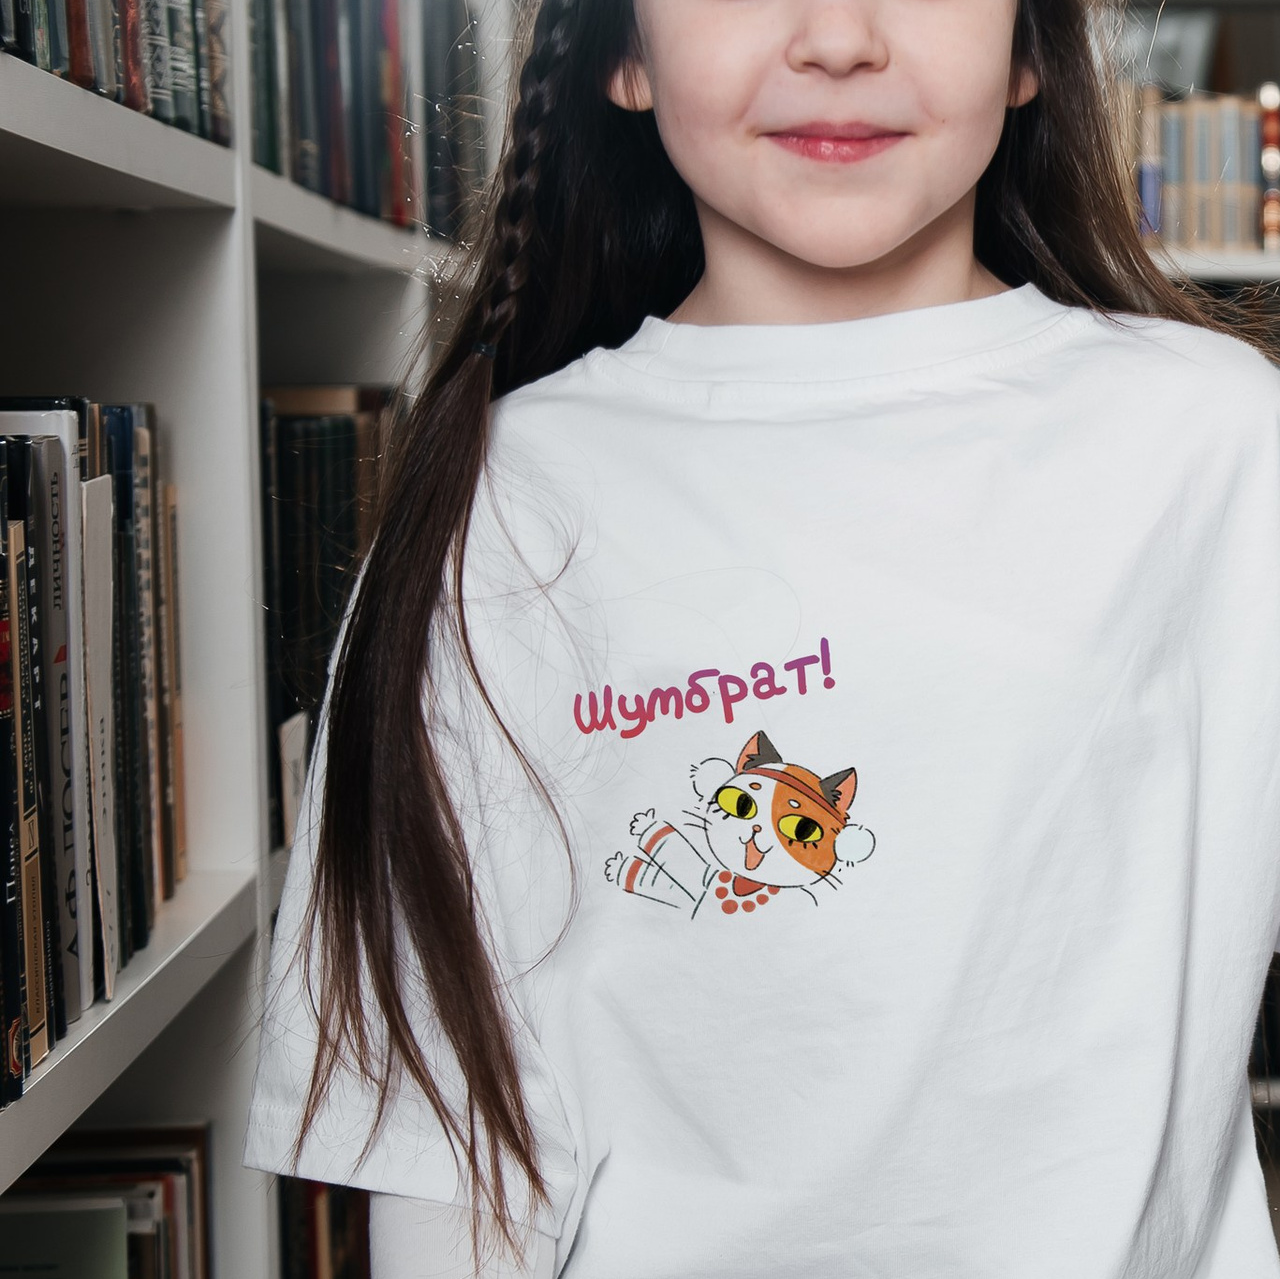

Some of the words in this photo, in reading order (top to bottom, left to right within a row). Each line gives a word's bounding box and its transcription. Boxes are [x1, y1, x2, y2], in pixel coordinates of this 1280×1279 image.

[50, 472, 62, 612] ЛИЧНОСТЬ
[573, 636, 836, 740] Шумбрат!
[32, 925, 41, 1015] КЛАССИЧЕСКАЯ
